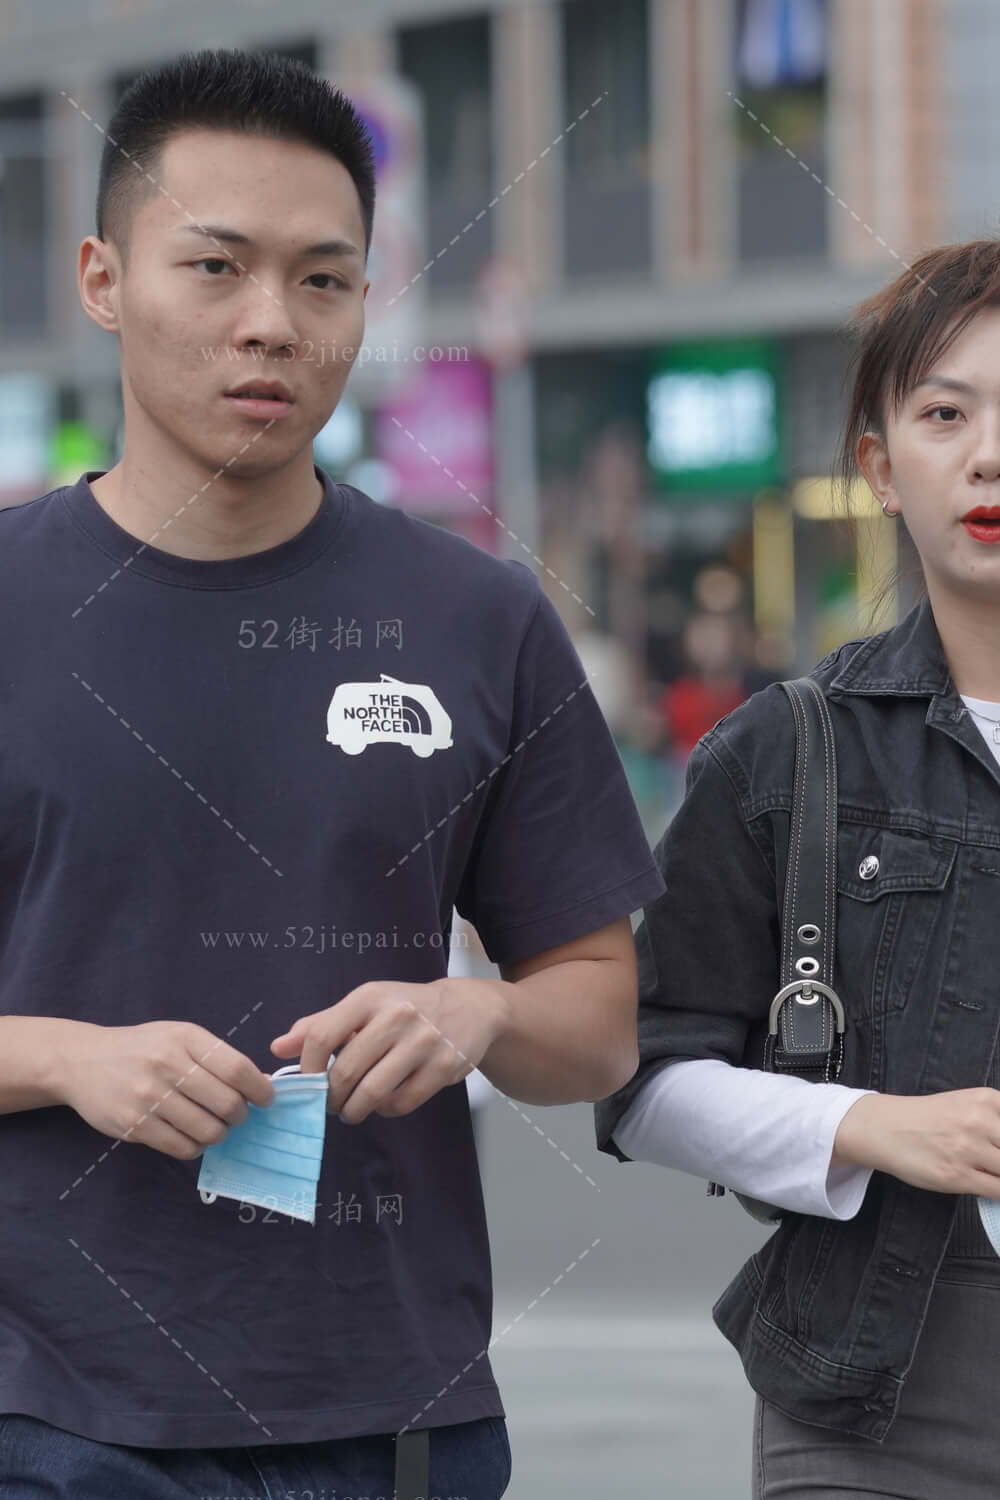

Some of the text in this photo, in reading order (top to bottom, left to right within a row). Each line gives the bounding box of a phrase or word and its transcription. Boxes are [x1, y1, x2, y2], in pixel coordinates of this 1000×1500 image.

[369, 694, 401, 707] THE
[344, 706, 402, 720] NORTH
[361, 719, 402, 733] FACE
